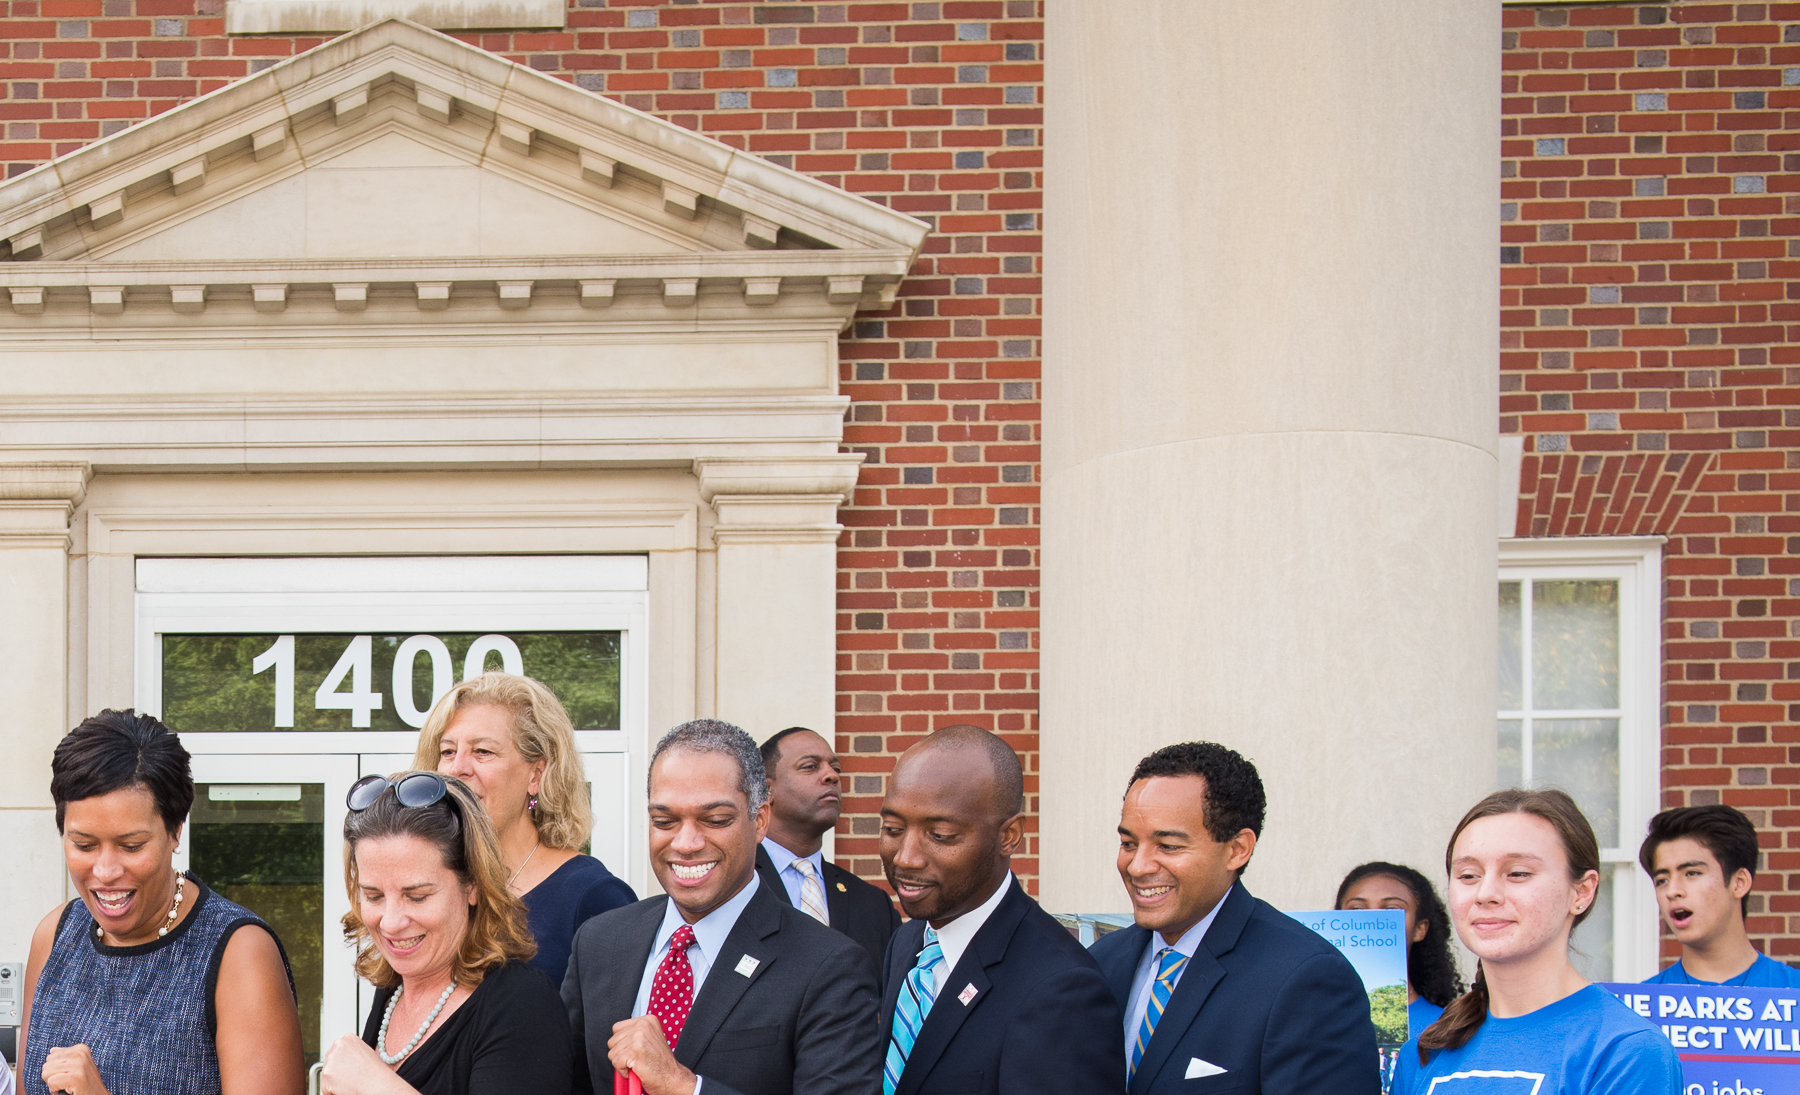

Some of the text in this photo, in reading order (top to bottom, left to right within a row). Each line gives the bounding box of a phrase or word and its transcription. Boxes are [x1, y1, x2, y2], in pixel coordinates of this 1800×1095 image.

[1312, 919, 1325, 930] of
[1331, 919, 1397, 930] Columbia
[1351, 936, 1396, 946] School
[1659, 995, 1753, 1020] PARKS
[1761, 999, 1796, 1021] AT
